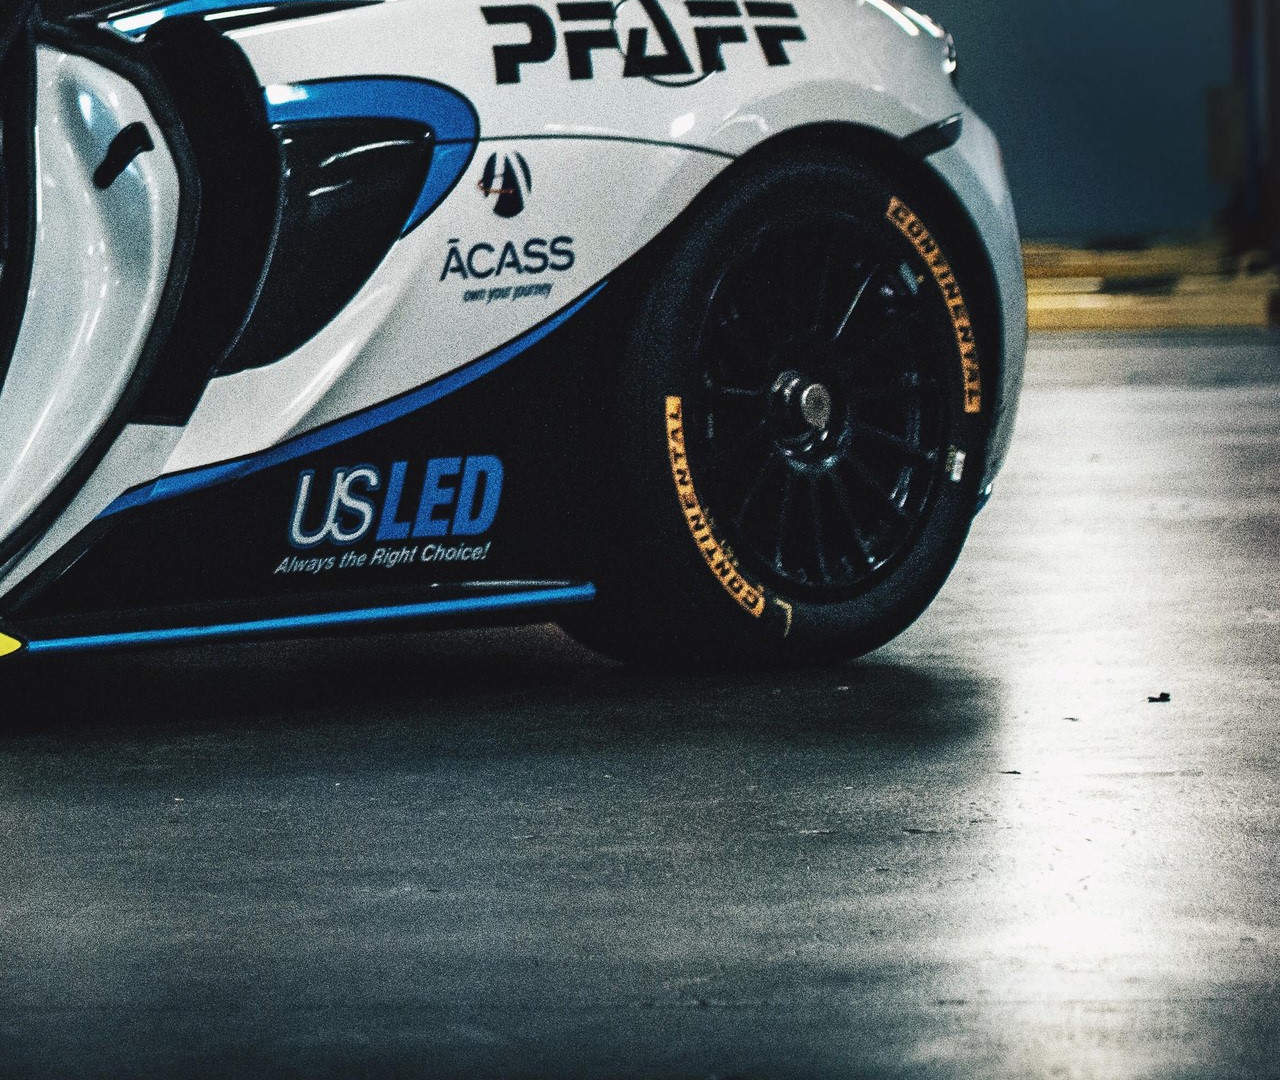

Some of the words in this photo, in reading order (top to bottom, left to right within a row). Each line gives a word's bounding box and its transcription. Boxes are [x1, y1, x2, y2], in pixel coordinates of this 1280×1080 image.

[274, 555, 336, 574] Always
[339, 551, 367, 568] the
[369, 545, 418, 568] Right
[421, 541, 491, 562] Choice!
